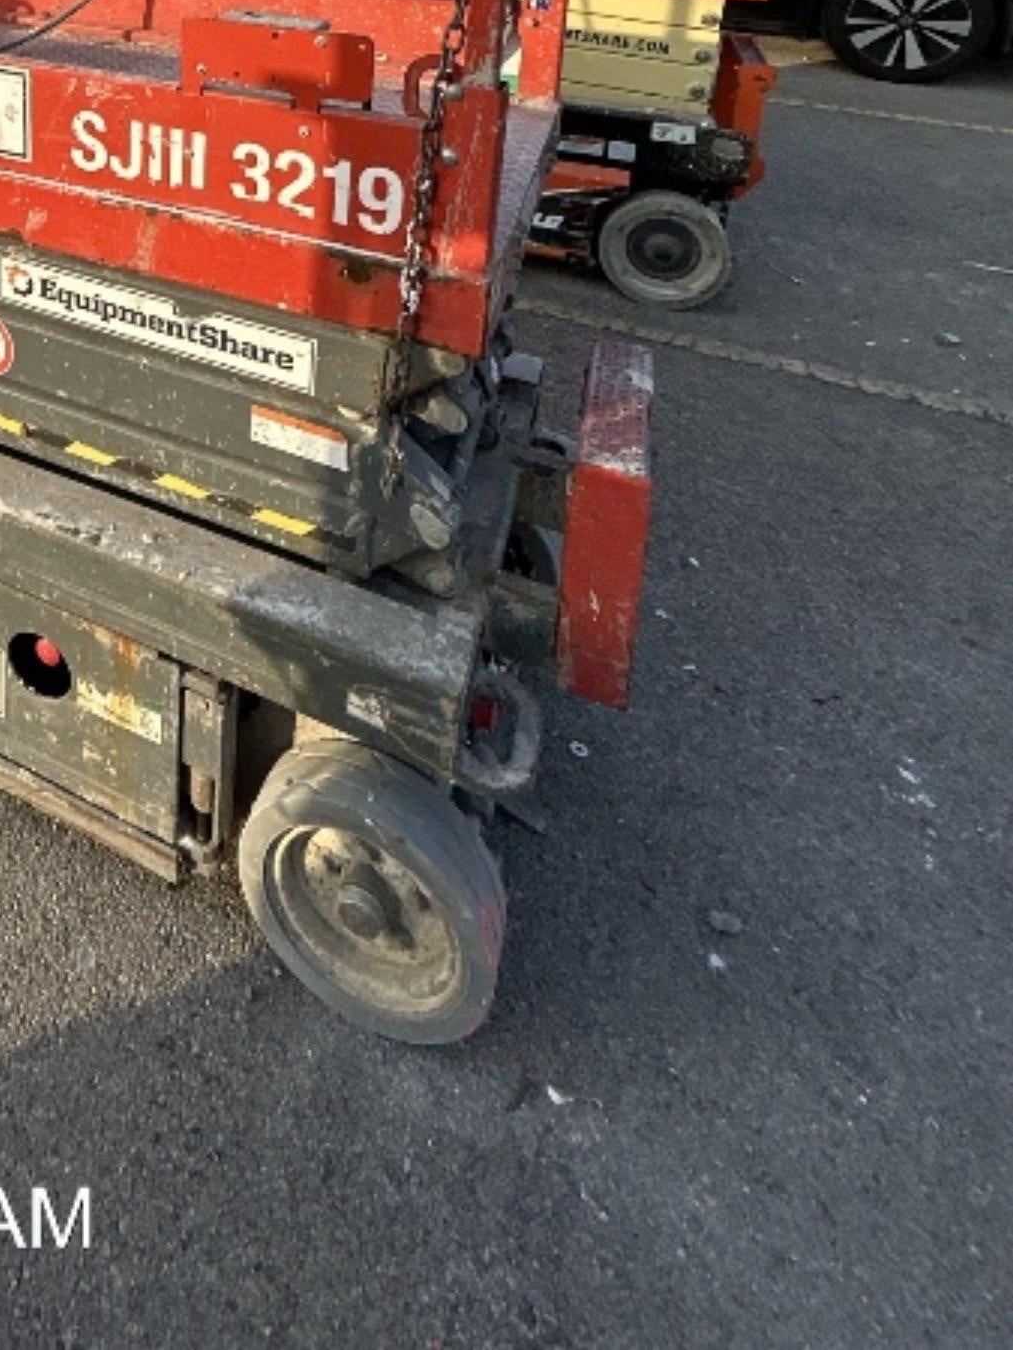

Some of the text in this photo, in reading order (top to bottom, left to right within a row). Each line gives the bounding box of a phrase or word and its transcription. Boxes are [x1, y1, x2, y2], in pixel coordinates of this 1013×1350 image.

[70, 110, 405, 235] SJIII 3219
[39, 277, 295, 371] EquipmentShare
